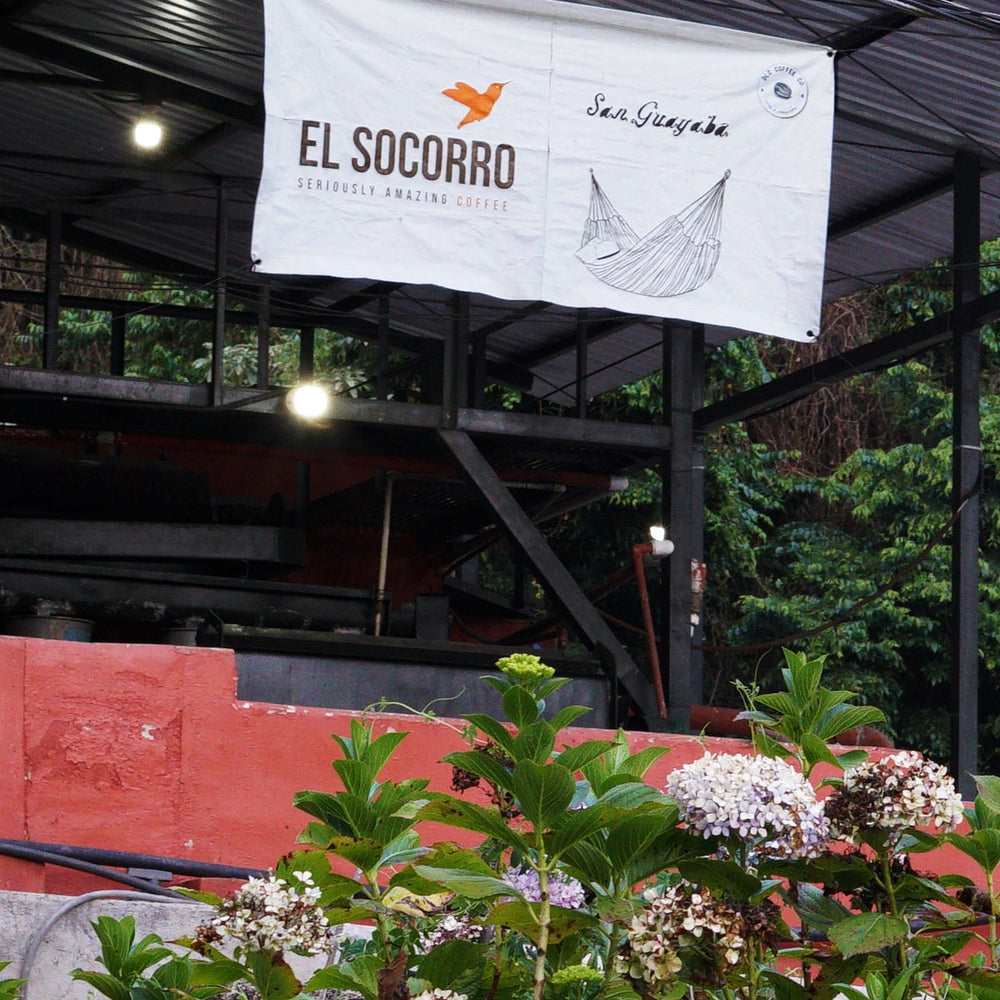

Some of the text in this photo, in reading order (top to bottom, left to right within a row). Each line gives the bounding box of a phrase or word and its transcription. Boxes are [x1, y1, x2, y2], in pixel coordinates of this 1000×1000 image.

[586, 92, 628, 121] San
[299, 120, 516, 190] EL SOCORRO
[297, 177, 509, 212] SERIOUSLY AMAZING COFFEE
